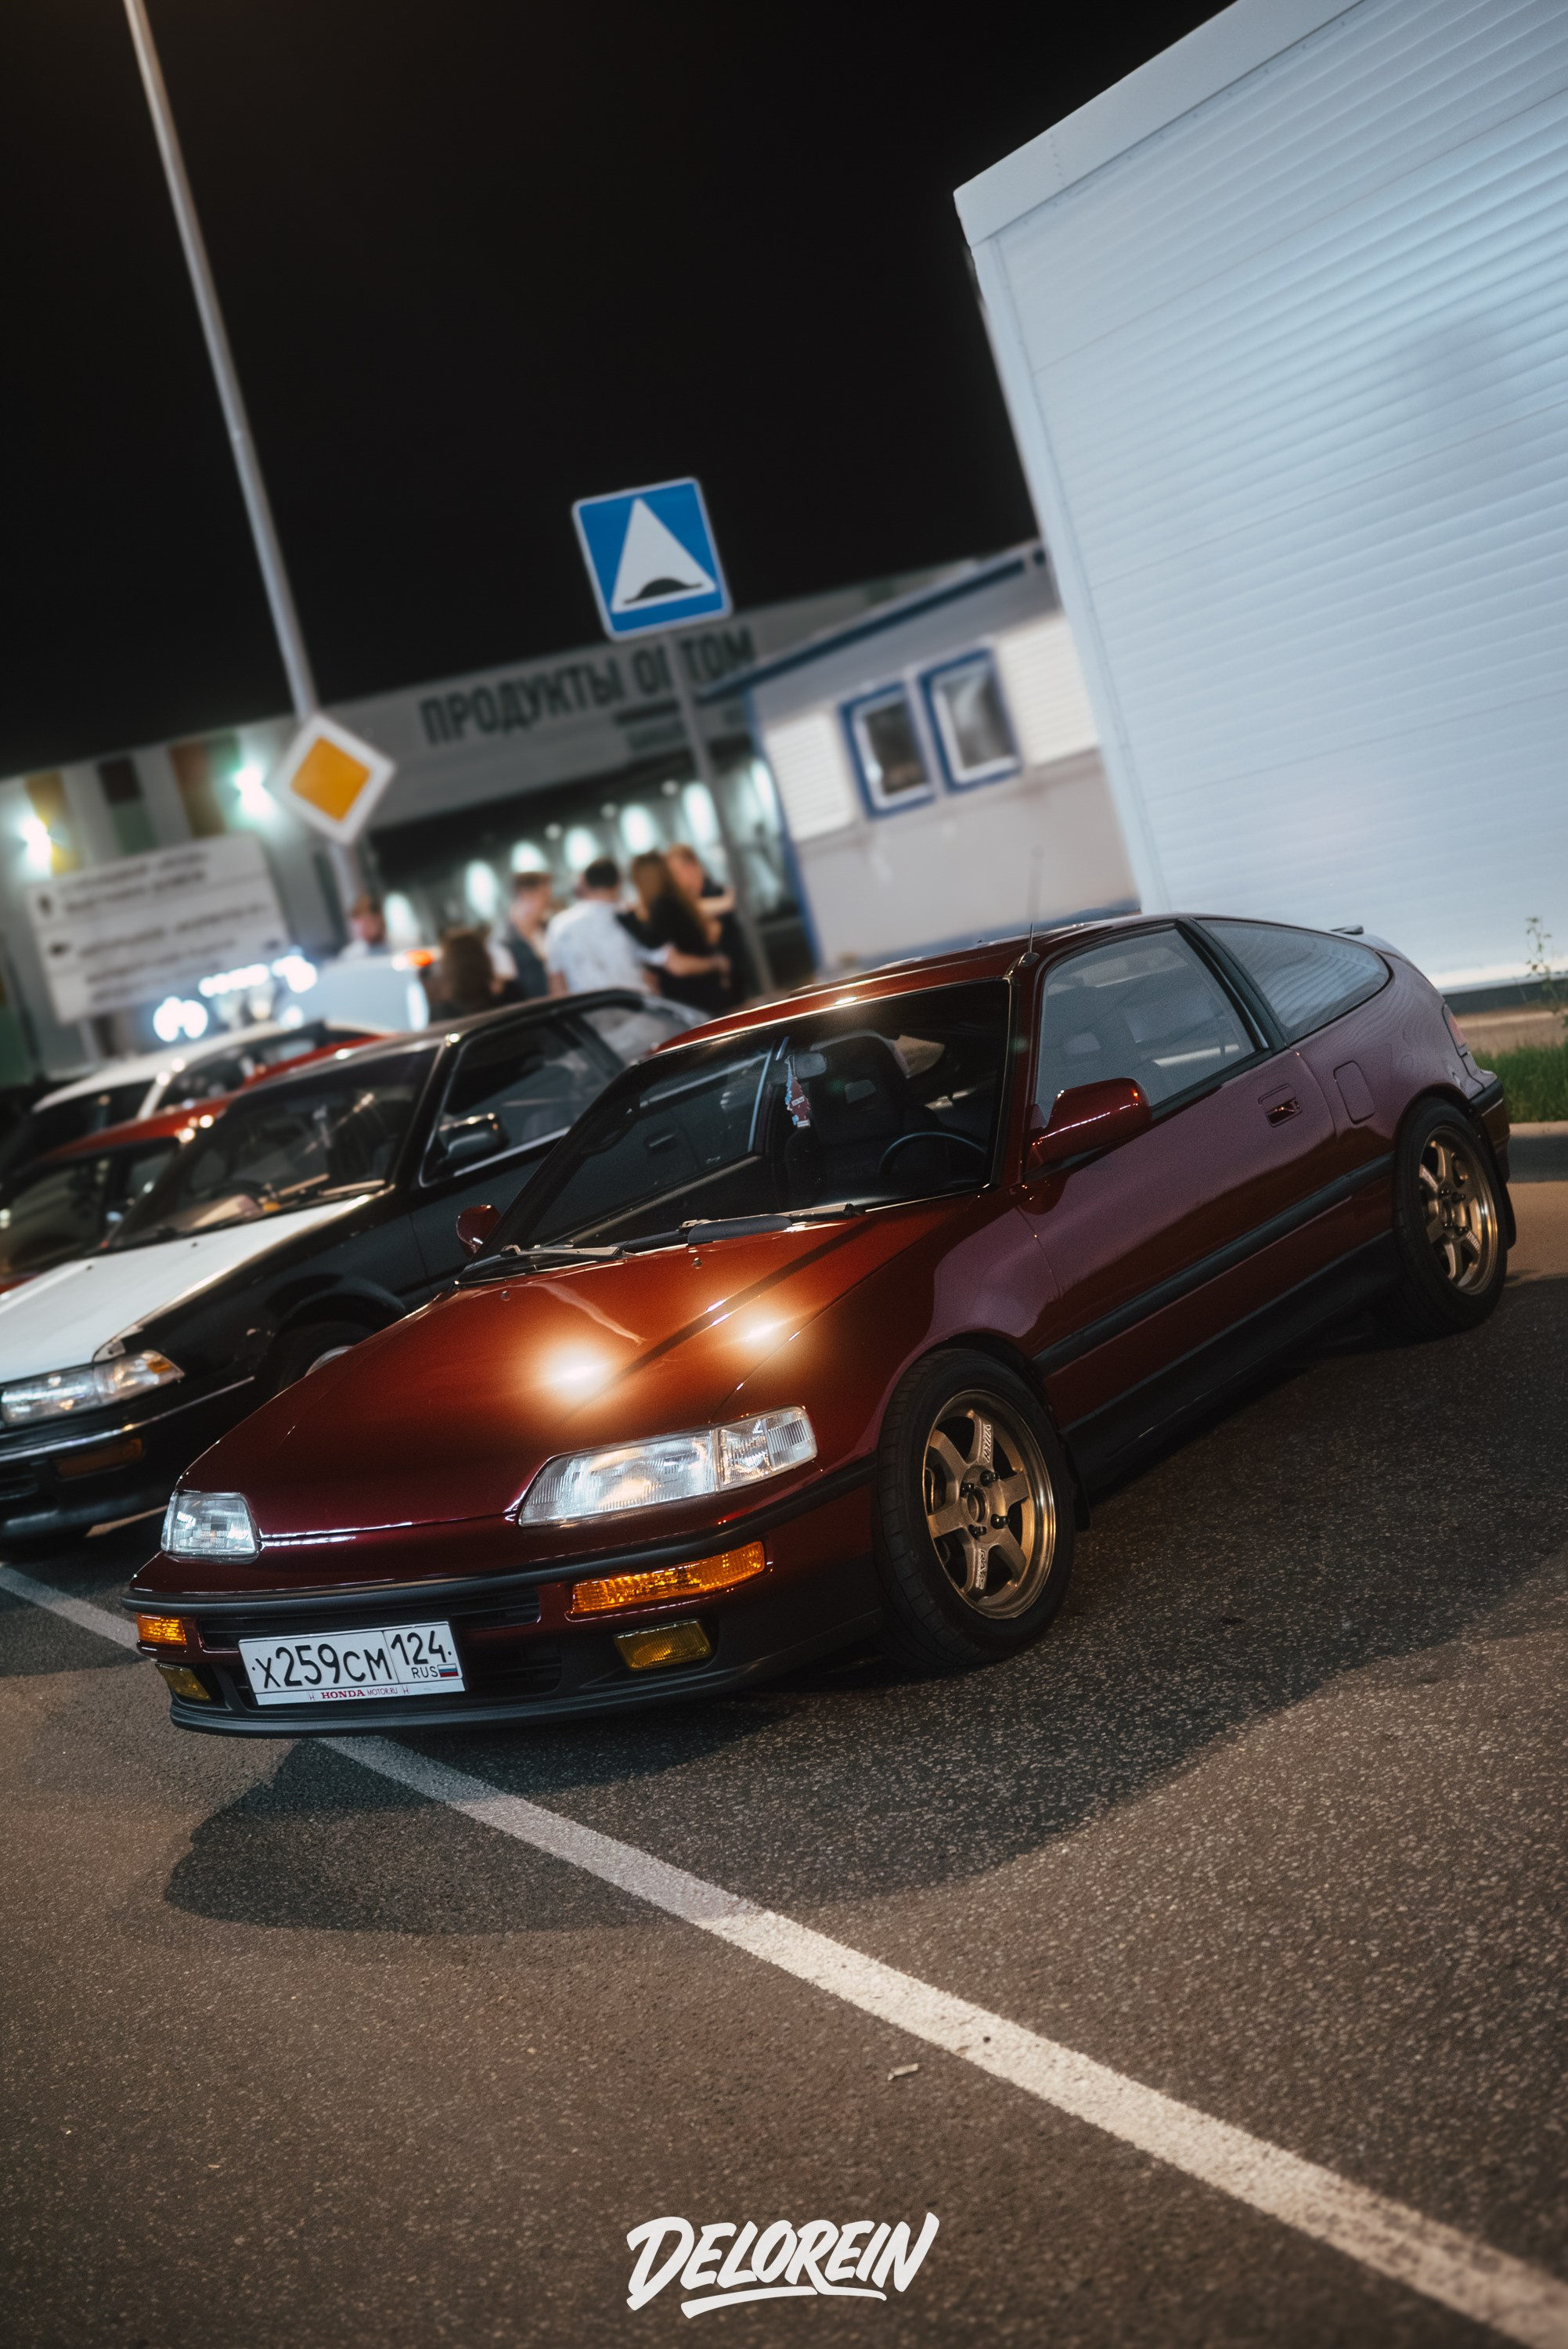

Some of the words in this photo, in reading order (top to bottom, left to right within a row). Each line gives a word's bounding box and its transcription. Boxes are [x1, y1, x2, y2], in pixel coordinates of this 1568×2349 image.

[420, 657, 625, 745] ПРОДУКТЫ
[391, 1630, 447, 1665] 124
[411, 1665, 438, 1680] RUS
[321, 1689, 366, 1700] HONDA
